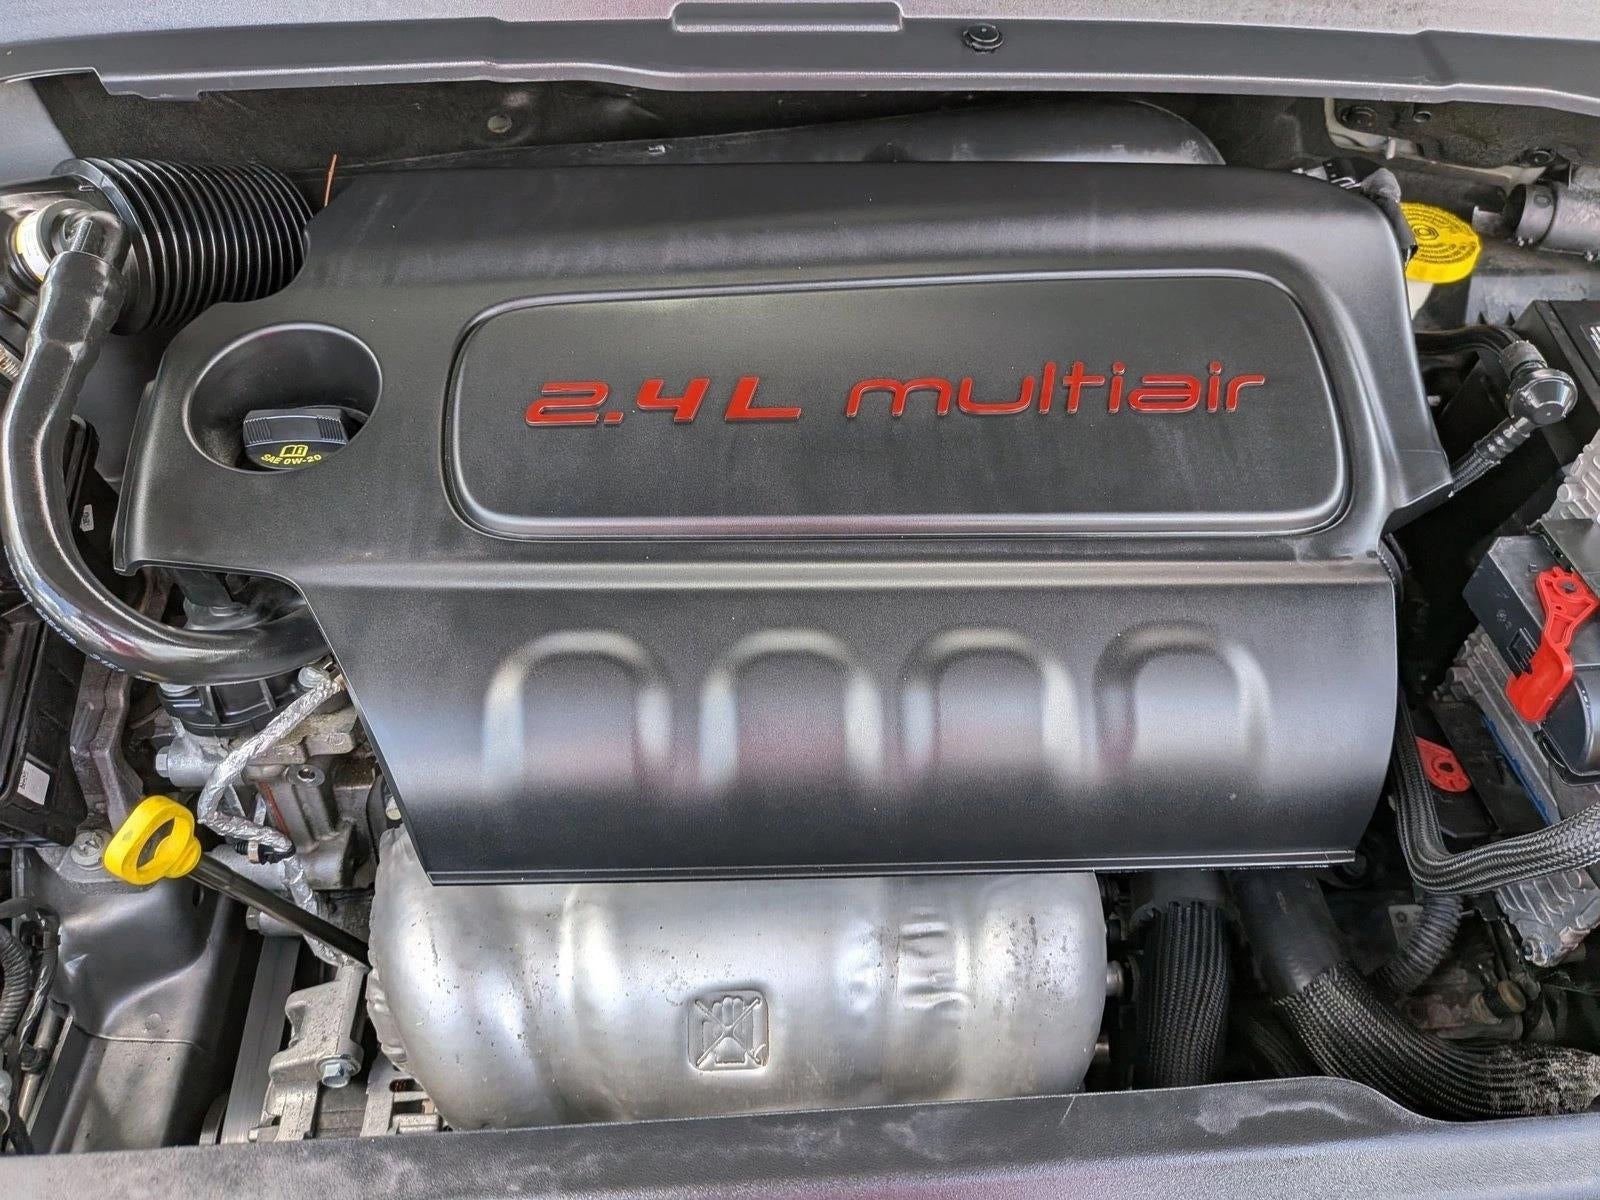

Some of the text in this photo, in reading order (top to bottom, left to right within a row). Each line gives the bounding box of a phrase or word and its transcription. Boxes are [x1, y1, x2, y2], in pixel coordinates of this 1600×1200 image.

[524, 360, 1266, 425] 2.4L multiair
[261, 453, 322, 465] SAE 0W-20
